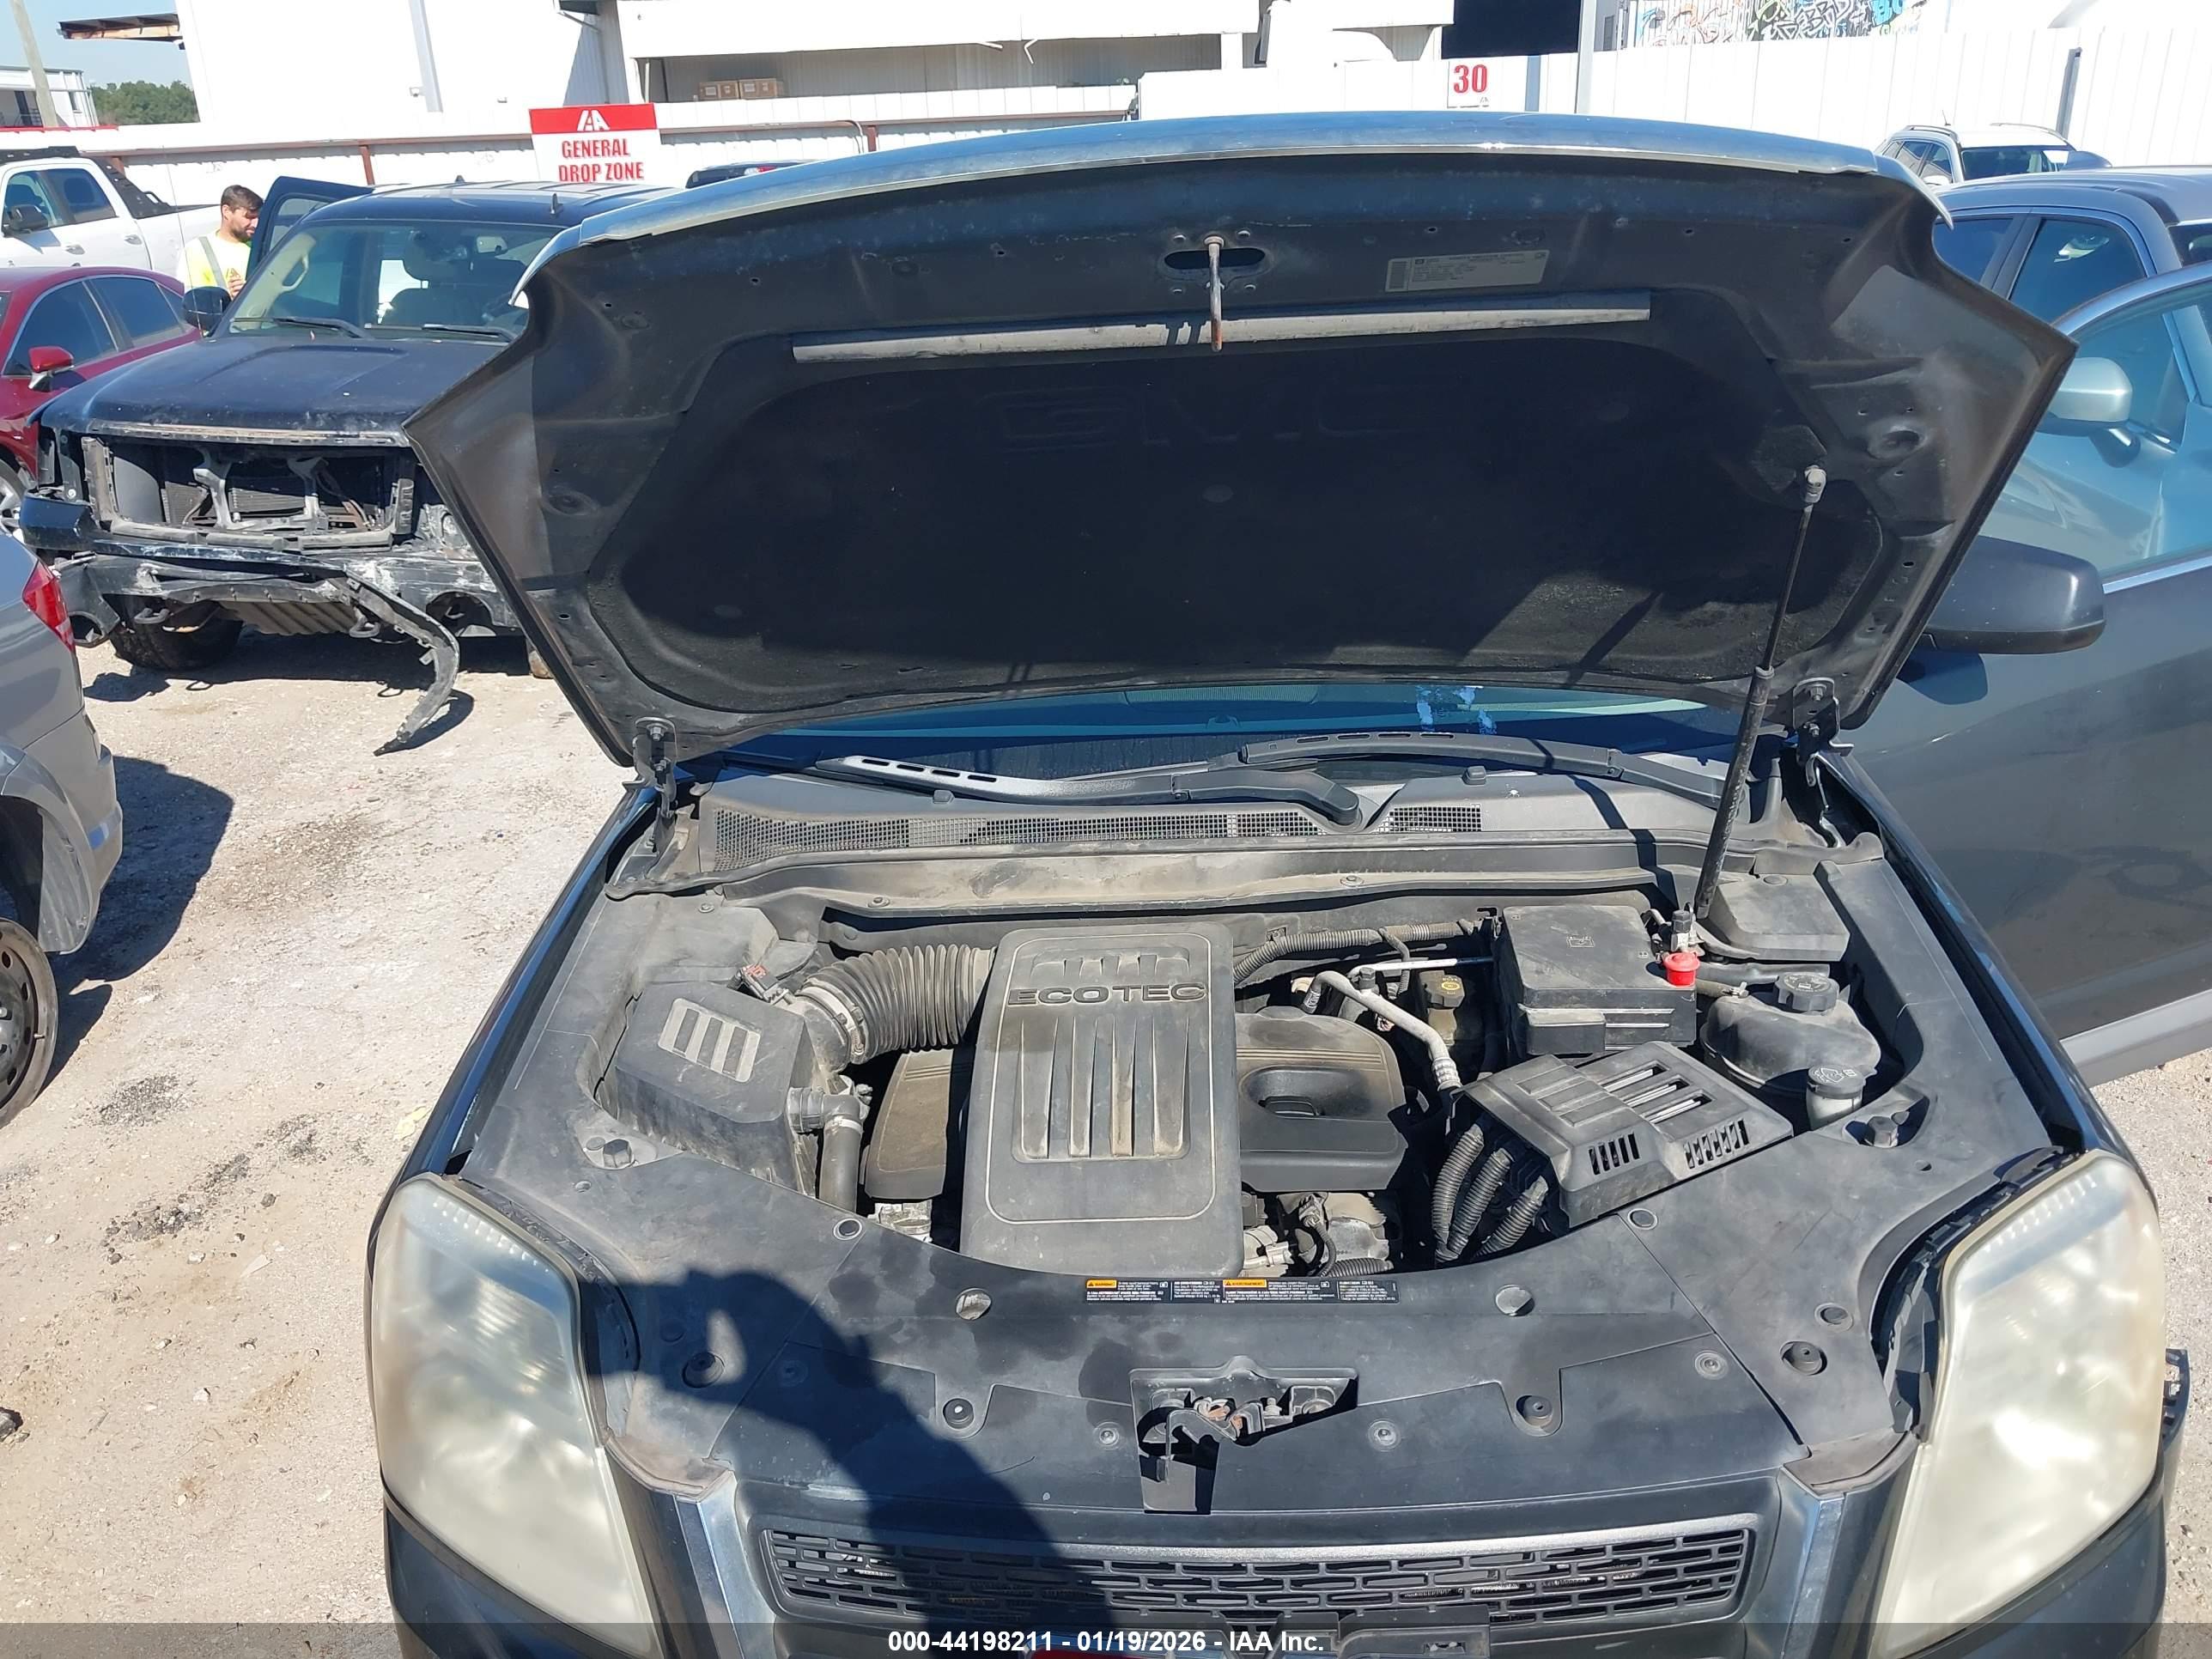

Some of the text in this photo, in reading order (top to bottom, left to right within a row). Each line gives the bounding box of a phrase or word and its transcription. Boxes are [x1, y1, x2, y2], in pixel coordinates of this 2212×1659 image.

[1453, 64, 1488, 94] 30
[561, 137, 630, 159] GENERAL
[558, 161, 644, 182] DROP ZONE
[1007, 982, 1207, 1006] ECOTEC
